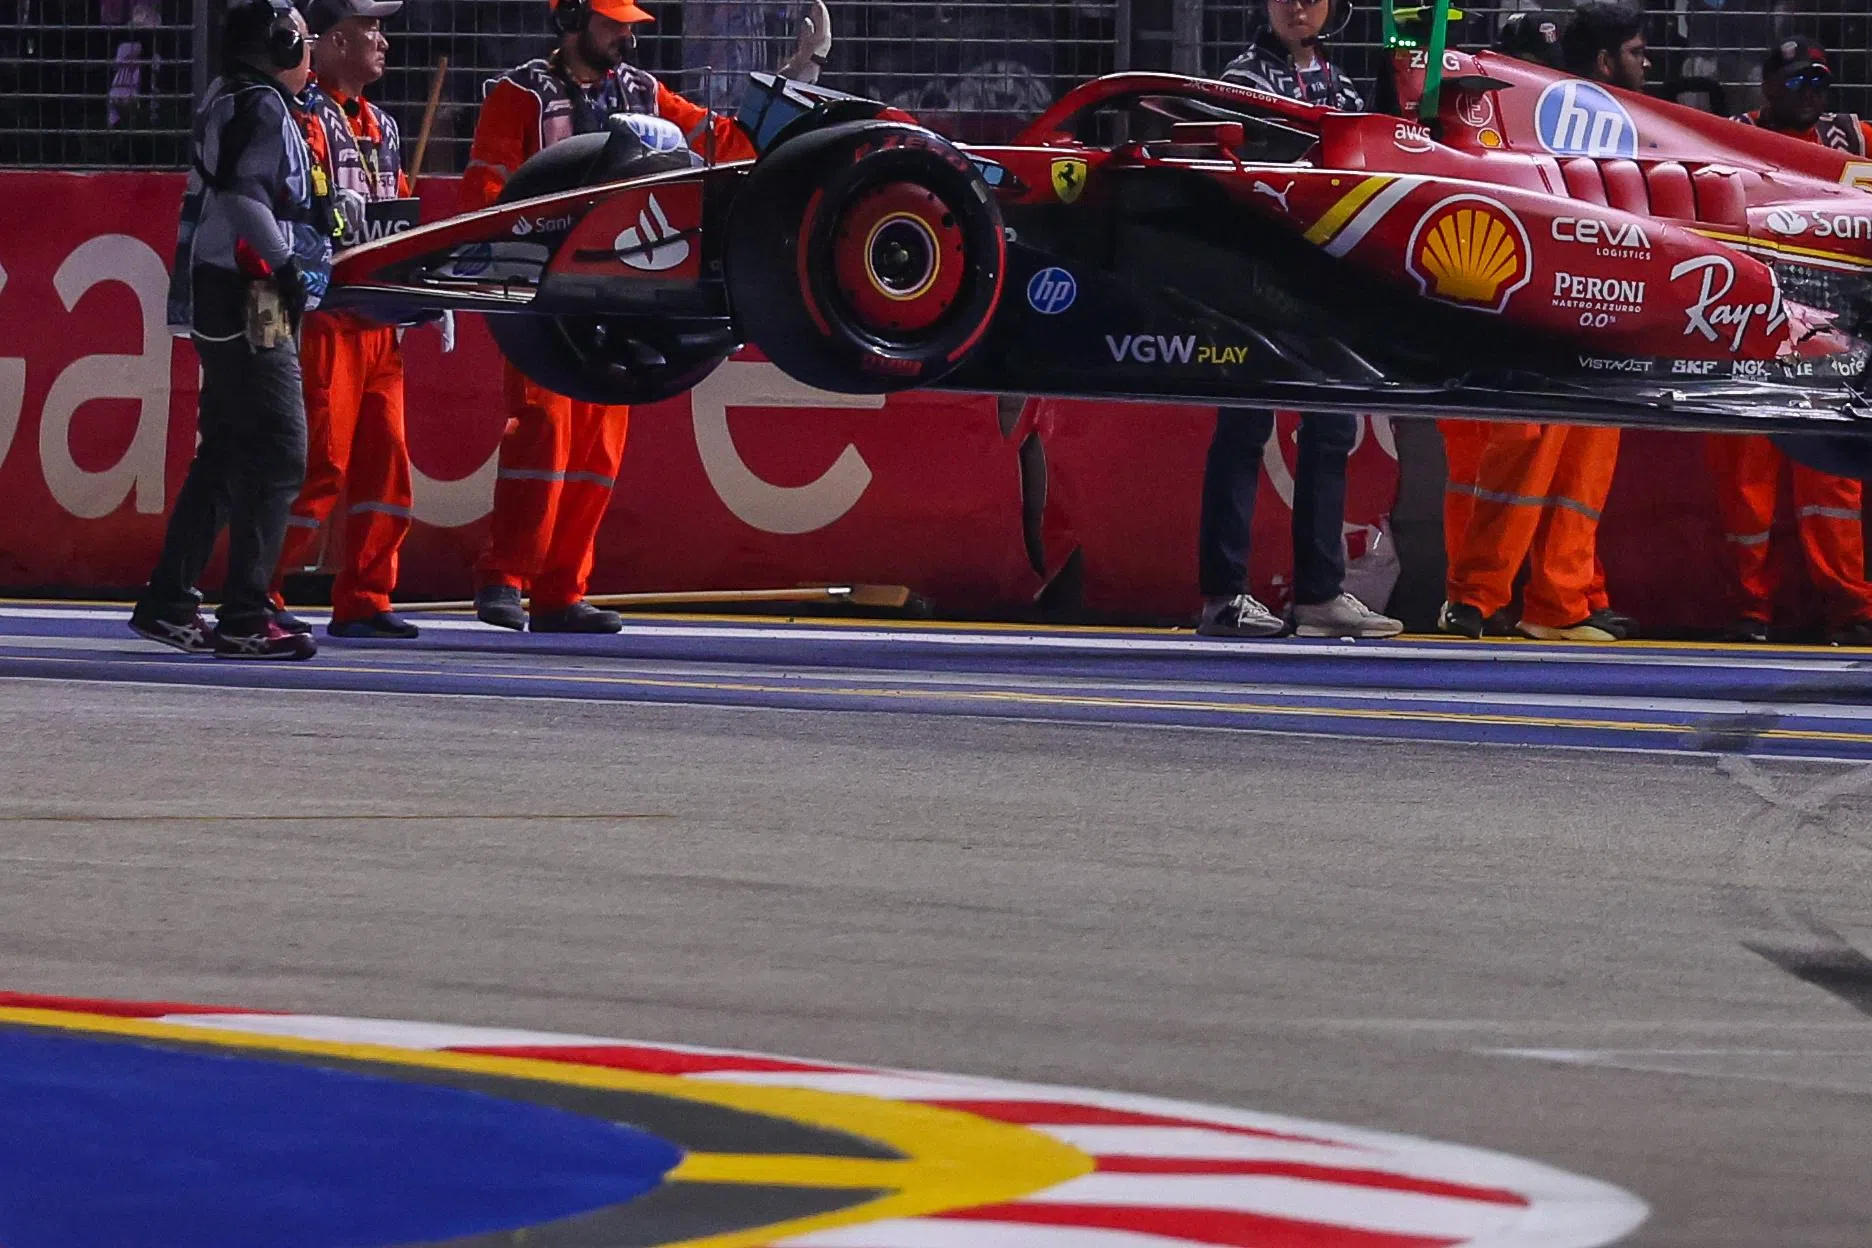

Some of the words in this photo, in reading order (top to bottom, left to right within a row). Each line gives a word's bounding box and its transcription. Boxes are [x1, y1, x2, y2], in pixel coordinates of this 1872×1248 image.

[1214, 84, 1279, 104] TECHNOLOGY
[1596, 247, 1651, 260] LOGISTICS
[1034, 270, 1071, 313] hp
[1554, 272, 1646, 304] PERONI
[1105, 334, 1196, 364] VGW
[1197, 346, 1249, 364] PLAY
[1671, 359, 1718, 375] SKF
[1732, 359, 1768, 376] NGK
